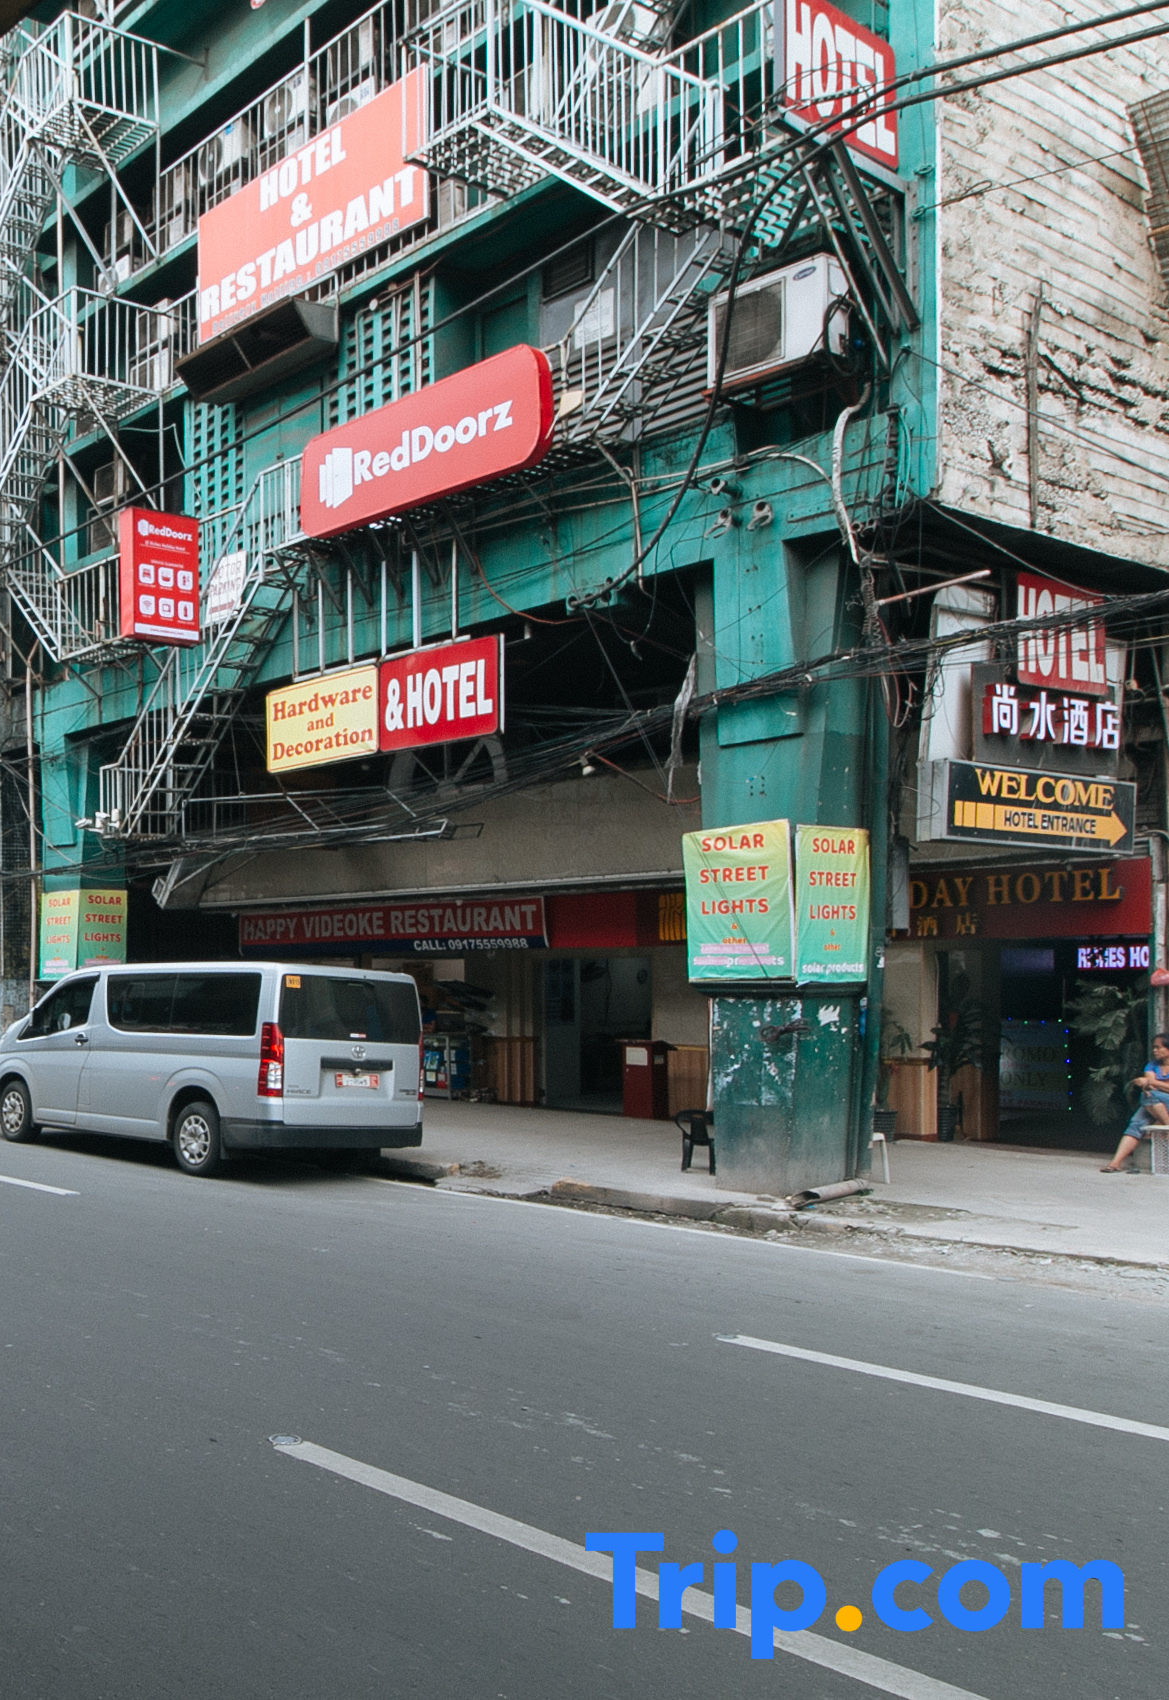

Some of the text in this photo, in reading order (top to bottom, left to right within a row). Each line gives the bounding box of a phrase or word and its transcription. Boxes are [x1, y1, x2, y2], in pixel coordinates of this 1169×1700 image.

[786, 0, 896, 157] HOTEL
[259, 126, 347, 213] HOTEL
[289, 191, 314, 227] &
[200, 164, 419, 324] RESTAURANT
[353, 400, 513, 485] RedDoorz
[148, 524, 193, 541] RedDoorz
[1018, 584, 1107, 686] HOTEL
[272, 682, 373, 722] Hardware
[306, 713, 334, 732] and
[992, 683, 1120, 750] 尚水酒店
[272, 726, 374, 761] Decoration
[975, 768, 1115, 810] WELCOME
[1004, 810, 1097, 835] HOTEL ENTRANCE
[701, 833, 765, 852] SOLAR
[812, 837, 855, 855] SOLAR
[699, 865, 770, 884] STREET
[809, 870, 857, 888] STREET
[909, 868, 1123, 909] DAY HOTEL
[48, 897, 71, 908] SOLAR
[88, 895, 122, 906] SOLAR
[700, 898, 769, 916] LIGHTS
[46, 916, 71, 926] STREET
[85, 913, 123, 924] STREET
[809, 904, 857, 921] LIGHTS
[243, 904, 537, 940] HAPPY VIDEOKE RESTAURANT
[731, 923, 738, 931] &
[46, 935, 70, 944] LIGHTS
[84, 932, 121, 942] LIGHTS
[413, 937, 528, 951] CALL: 09175559988
[722, 937, 747, 945] other
[823, 943, 841, 951] other
[802, 962, 864, 975] solar products
